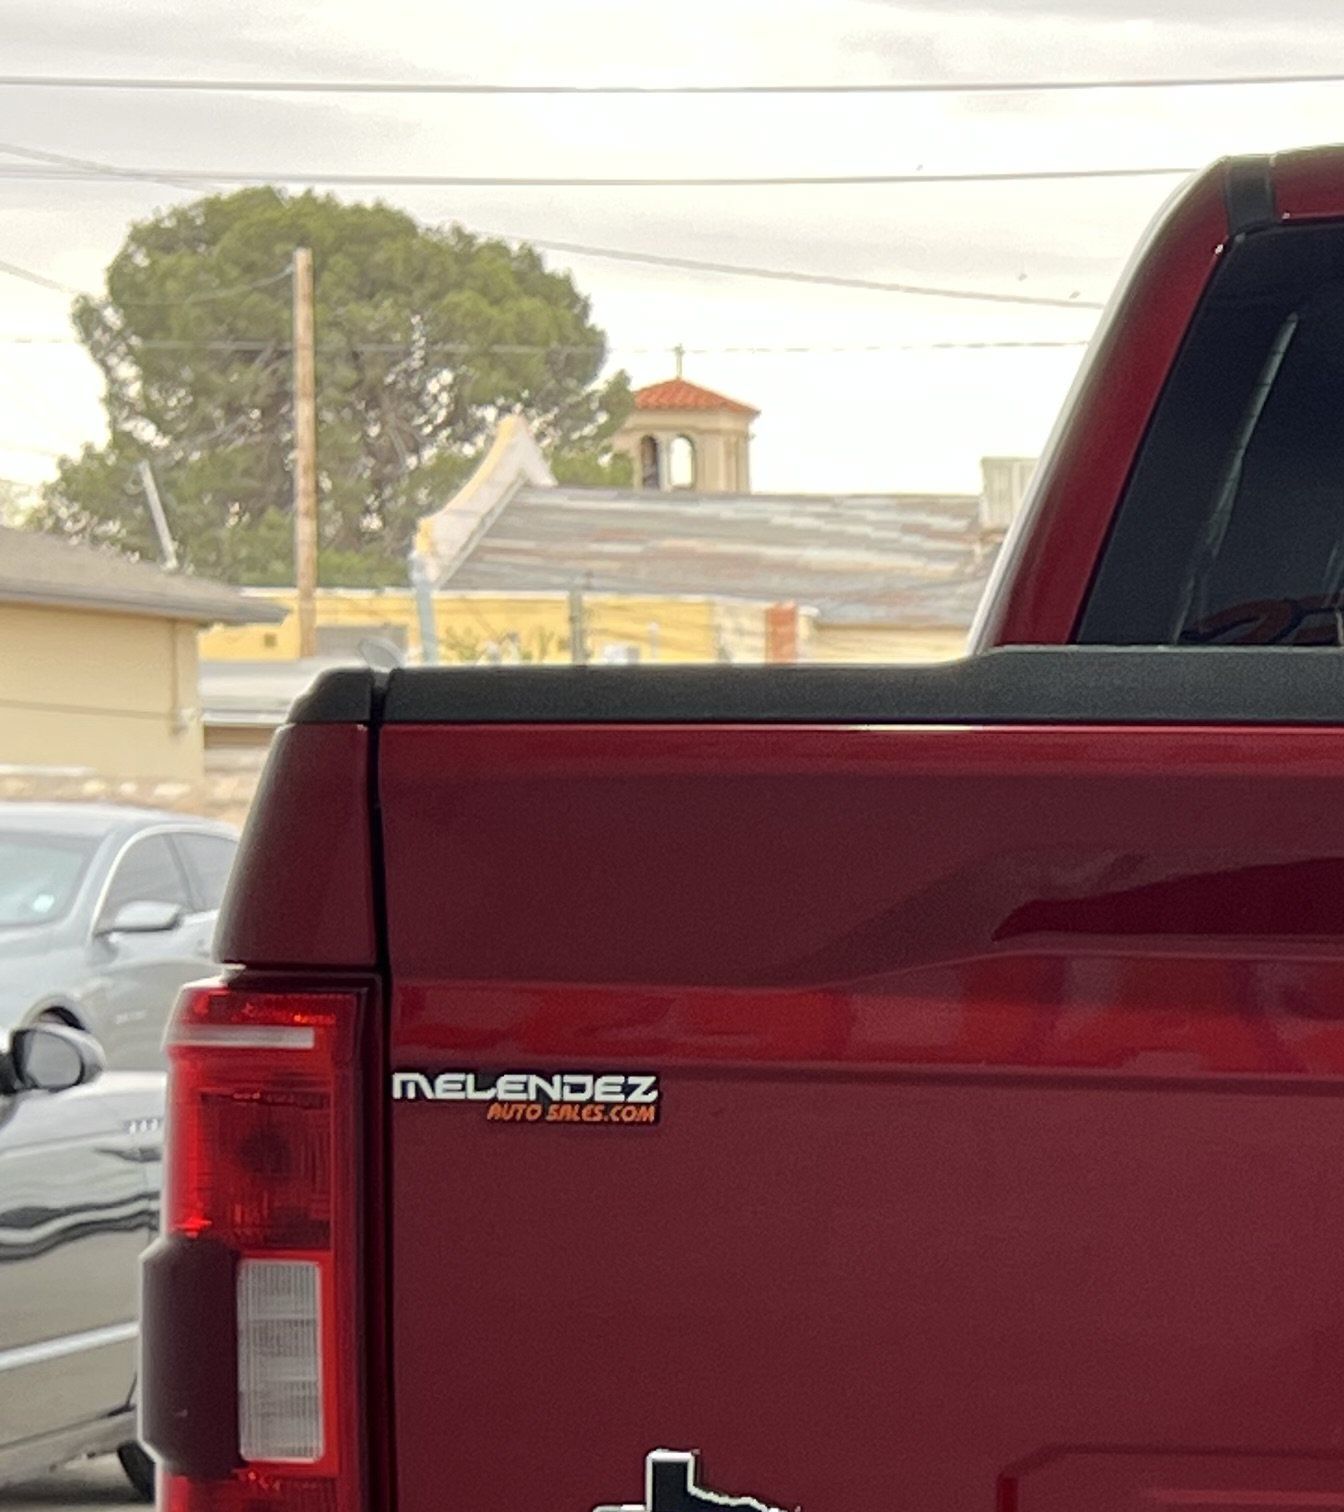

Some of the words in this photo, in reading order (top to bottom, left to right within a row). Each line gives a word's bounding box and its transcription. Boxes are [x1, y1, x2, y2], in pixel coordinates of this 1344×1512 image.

[392, 1072, 658, 1102] MELENDEZ
[487, 1103, 542, 1120] AUTO
[546, 1104, 655, 1121] SALES.COM
